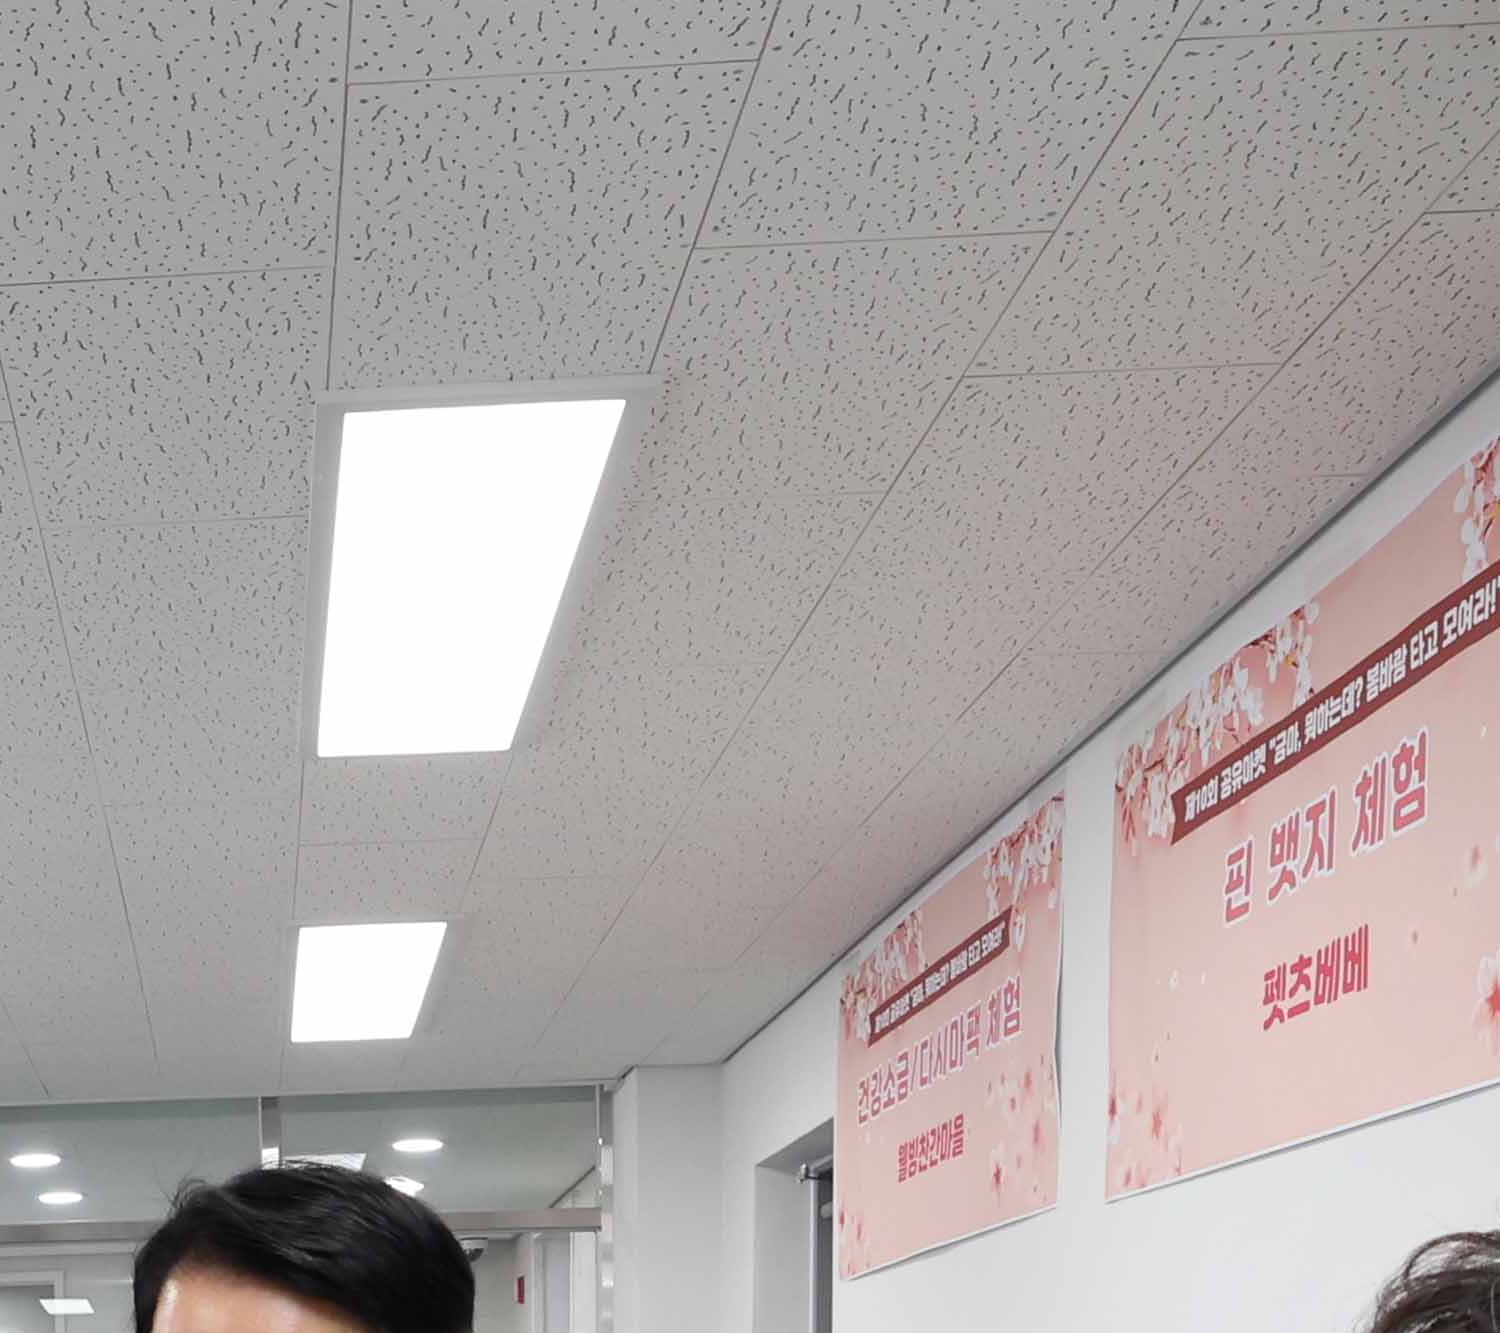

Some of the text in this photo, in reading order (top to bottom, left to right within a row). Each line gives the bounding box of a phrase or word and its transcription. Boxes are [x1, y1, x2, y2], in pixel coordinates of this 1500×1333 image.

[1185, 776, 1218, 823] 제10회
[1221, 743, 1267, 800] 공유마켓
[1366, 643, 1408, 702] 봄바람
[1409, 621, 1439, 670] 타고
[1225, 731, 1427, 923] 핀 뱃지 체험
[986, 975, 1021, 1046] 체험
[1263, 923, 1369, 1032] 펫츠베베
